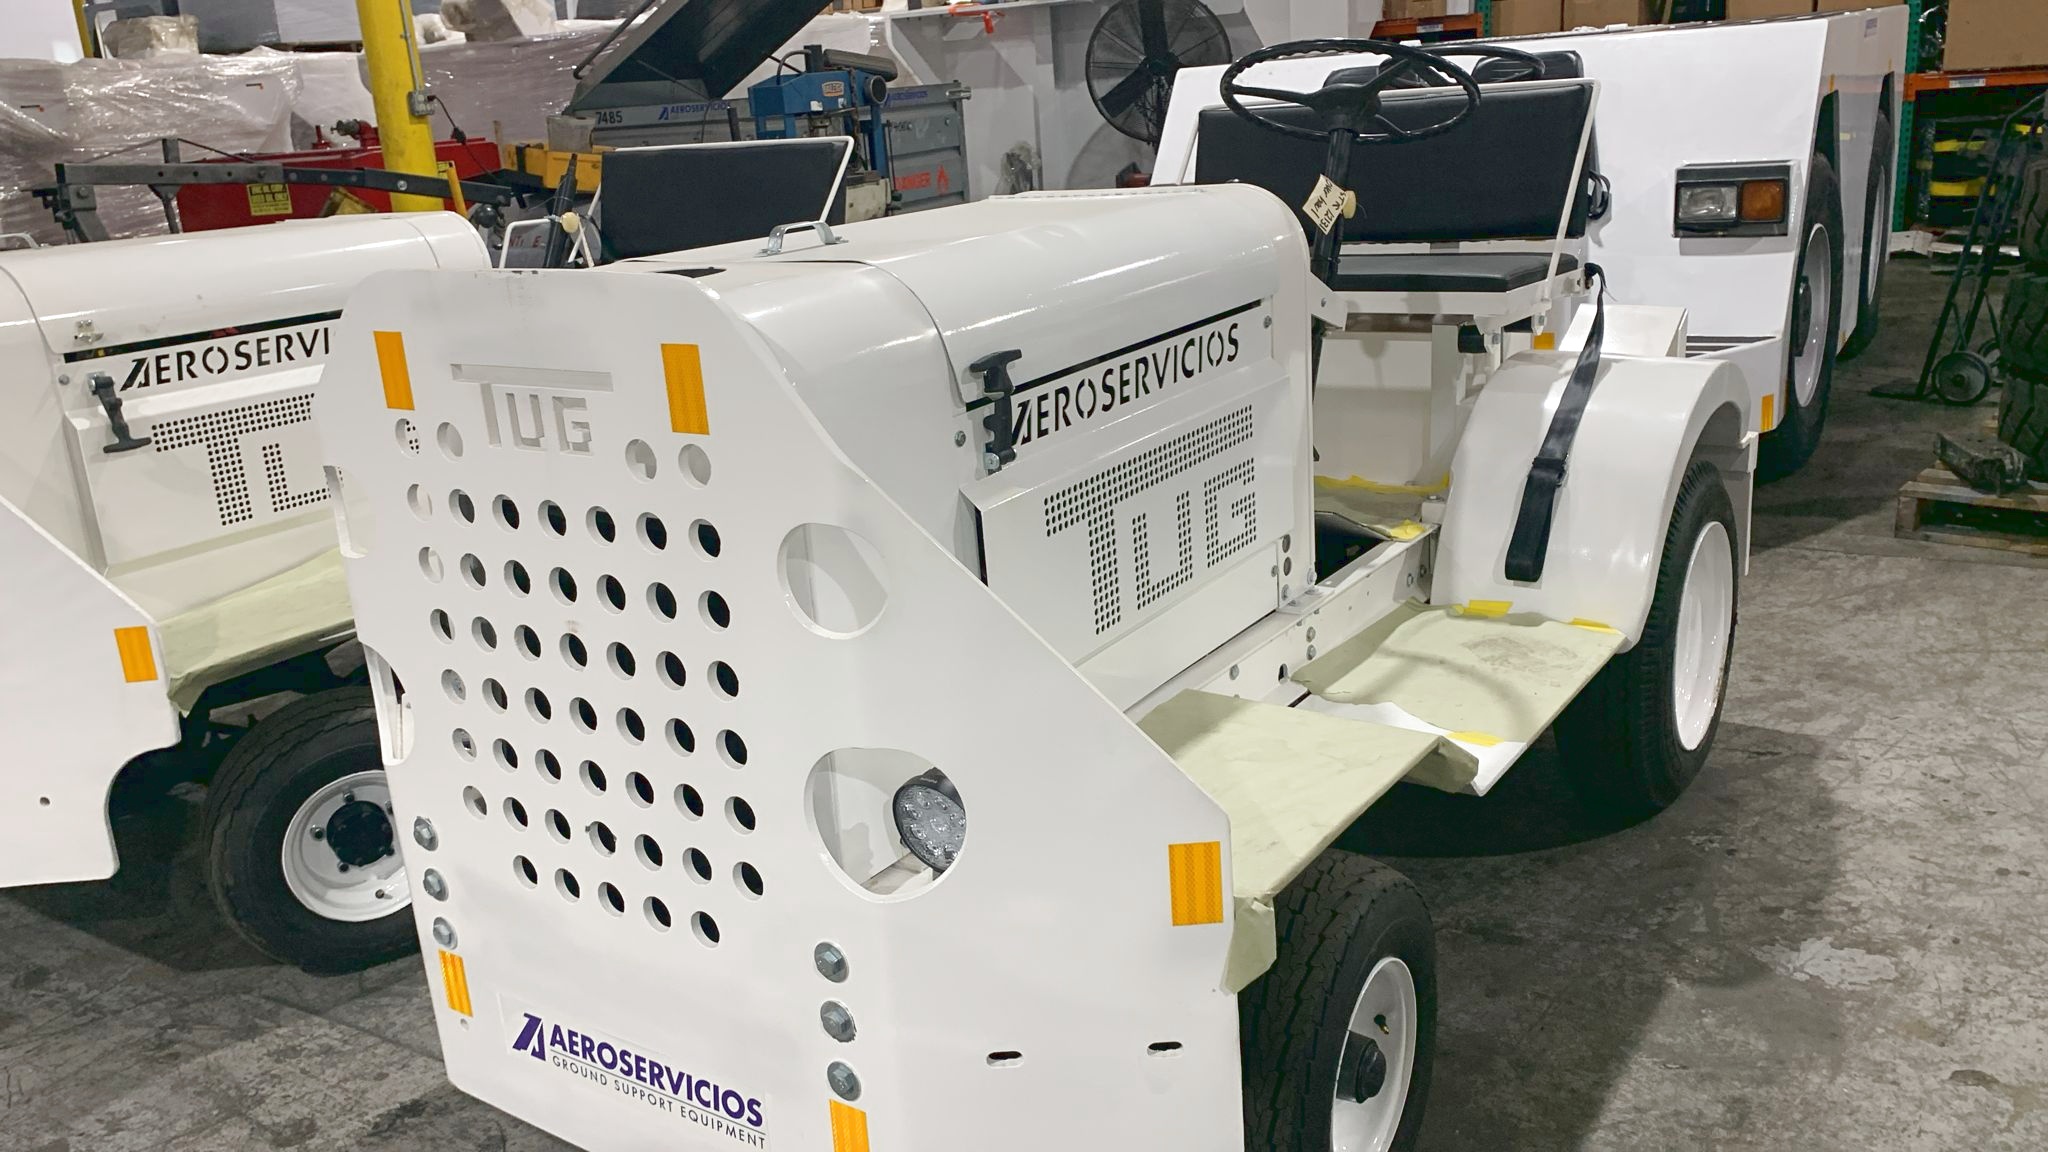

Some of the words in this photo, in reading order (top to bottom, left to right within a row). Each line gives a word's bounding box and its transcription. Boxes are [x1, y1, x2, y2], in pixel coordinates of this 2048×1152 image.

[595, 111, 623, 125] 7485
[450, 363, 614, 457] TUG
[1011, 322, 1239, 446] AEROSERVICIOS
[1043, 403, 1257, 635] TUG
[549, 1023, 763, 1127] AEROSERVICIOS
[552, 1055, 608, 1086] GROUND
[614, 1079, 673, 1113] SUPPORT
[680, 1105, 765, 1150] EQUIPMENT
